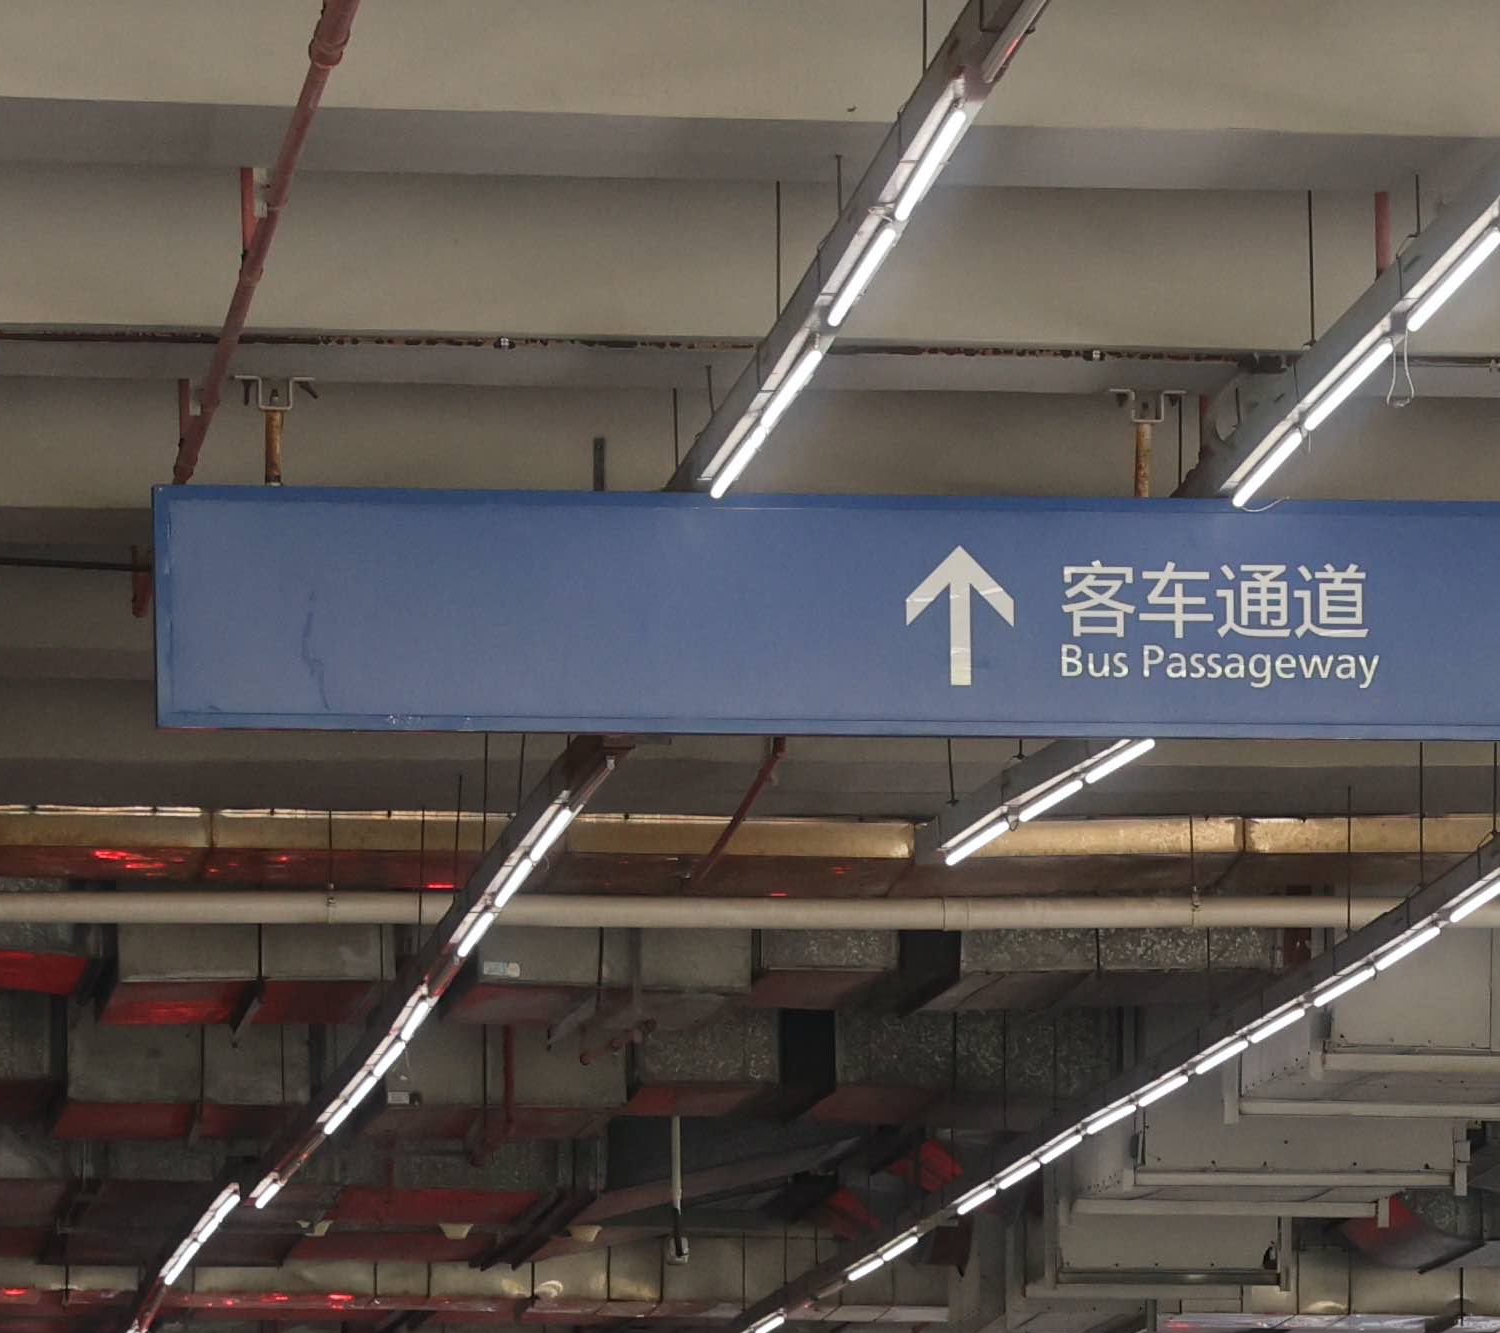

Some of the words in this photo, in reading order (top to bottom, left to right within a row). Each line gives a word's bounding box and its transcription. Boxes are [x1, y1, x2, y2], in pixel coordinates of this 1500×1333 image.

[1061, 561, 1369, 639] 客车通道
[1060, 644, 1128, 677] Bus
[1142, 644, 1379, 688] Passageway
